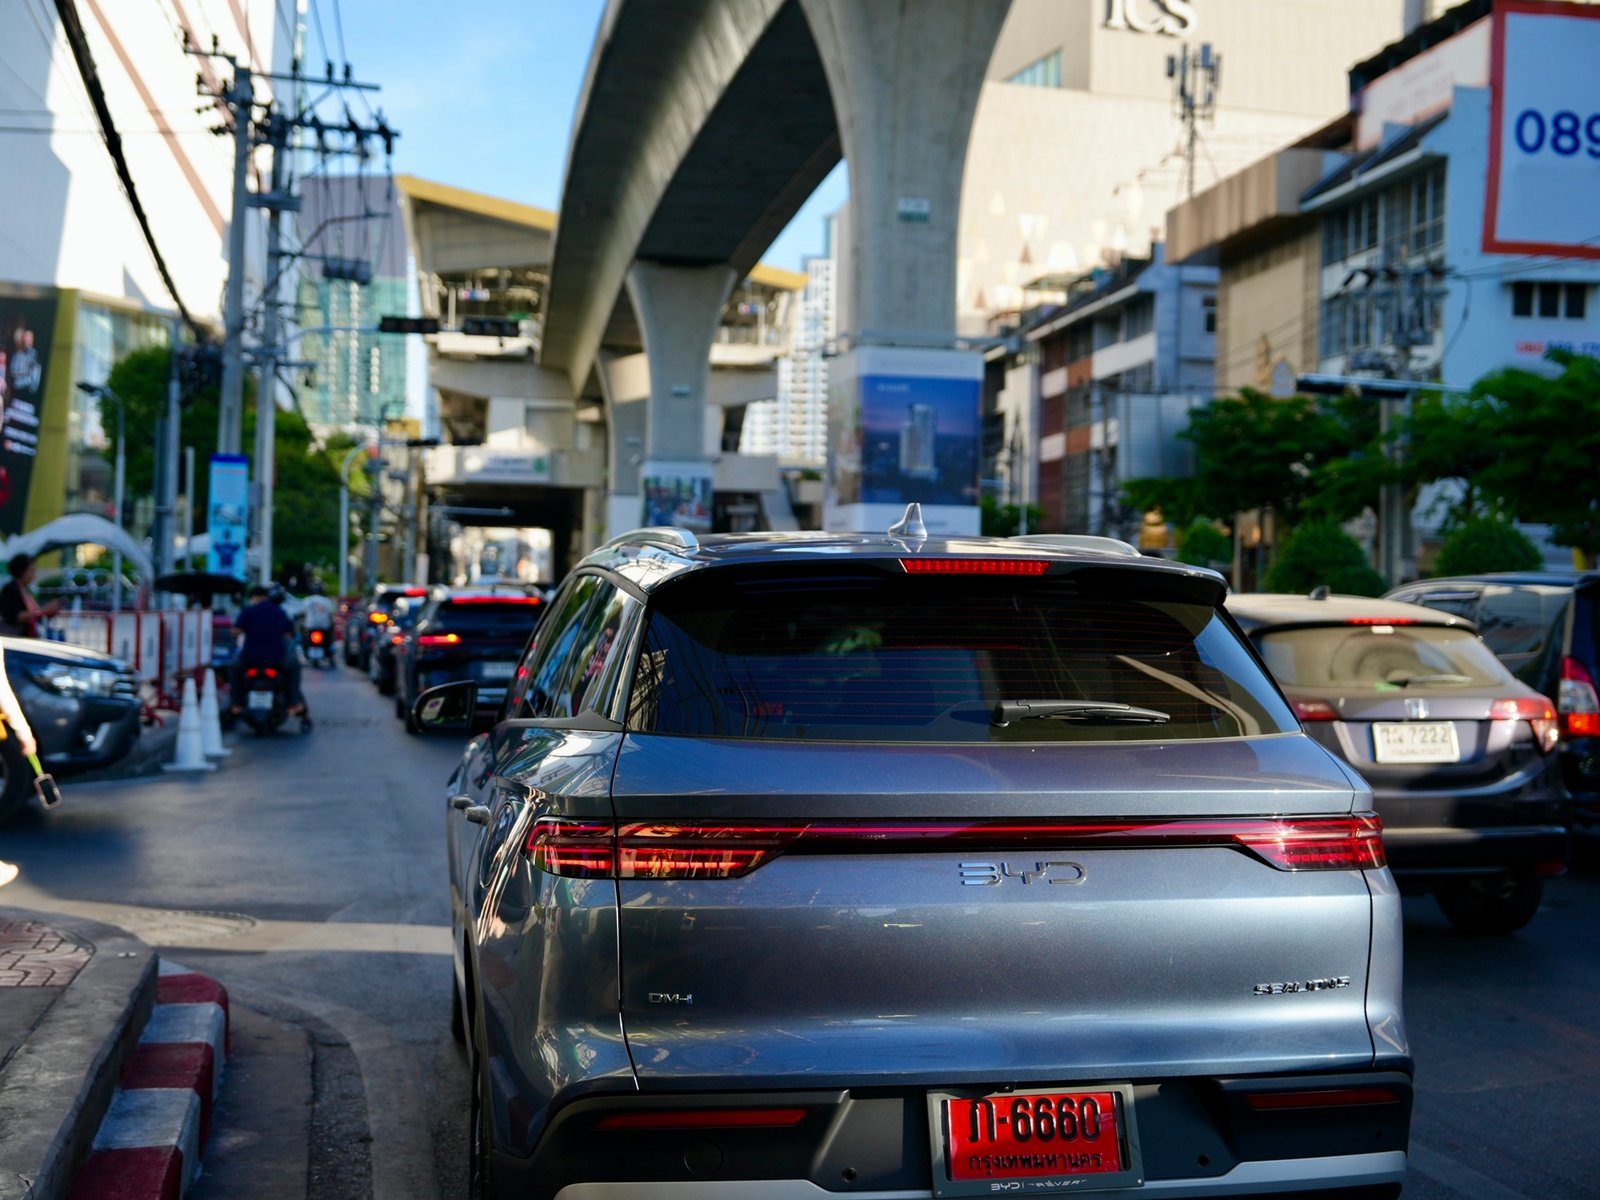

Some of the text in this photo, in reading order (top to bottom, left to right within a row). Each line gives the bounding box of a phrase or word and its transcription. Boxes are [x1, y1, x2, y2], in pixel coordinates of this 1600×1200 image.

[959, 861, 1087, 885] BYD
[969, 1153, 1103, 1176] กรุงเทพมหานคร
[991, 1182, 1020, 1191] BYD
